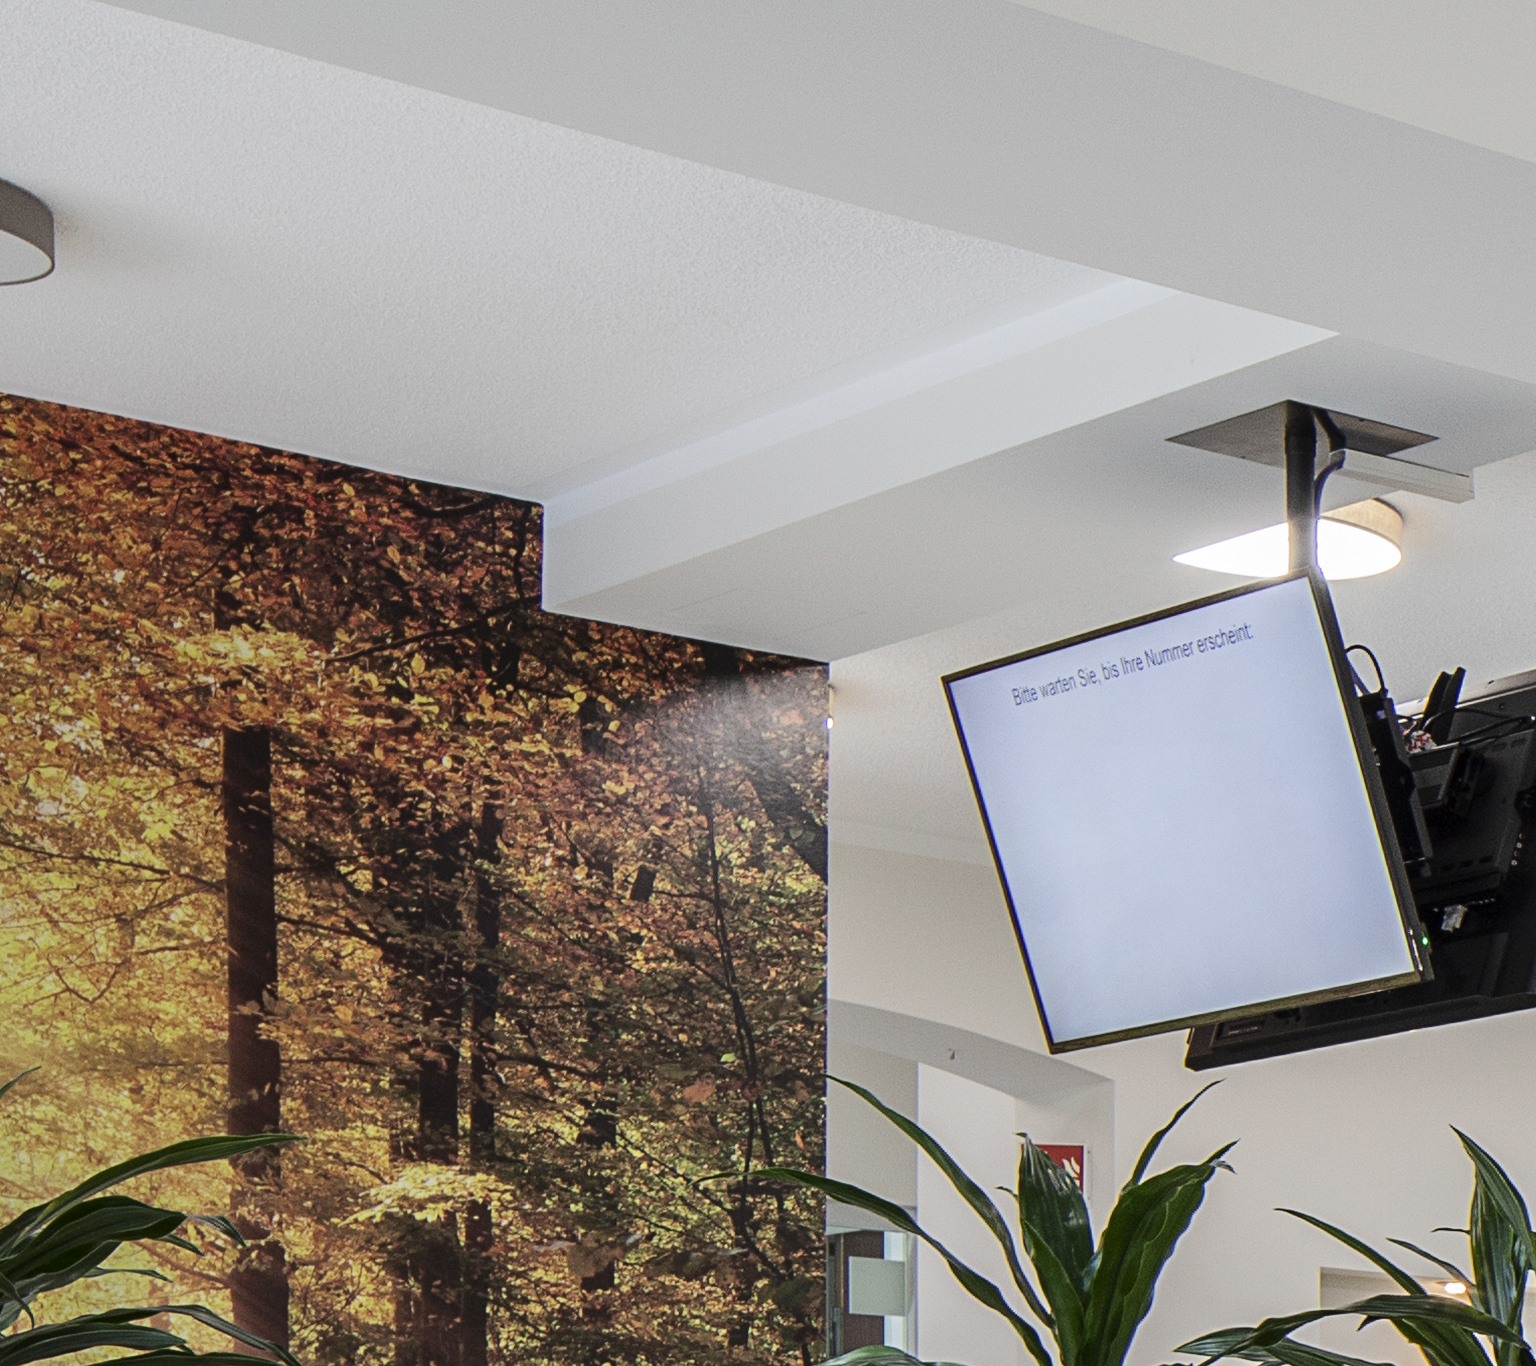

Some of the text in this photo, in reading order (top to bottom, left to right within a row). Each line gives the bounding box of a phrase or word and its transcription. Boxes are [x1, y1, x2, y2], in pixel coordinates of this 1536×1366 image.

[1011, 622, 1254, 706] Bitte warten Sie, bis Ihre Nummer erscheint:
